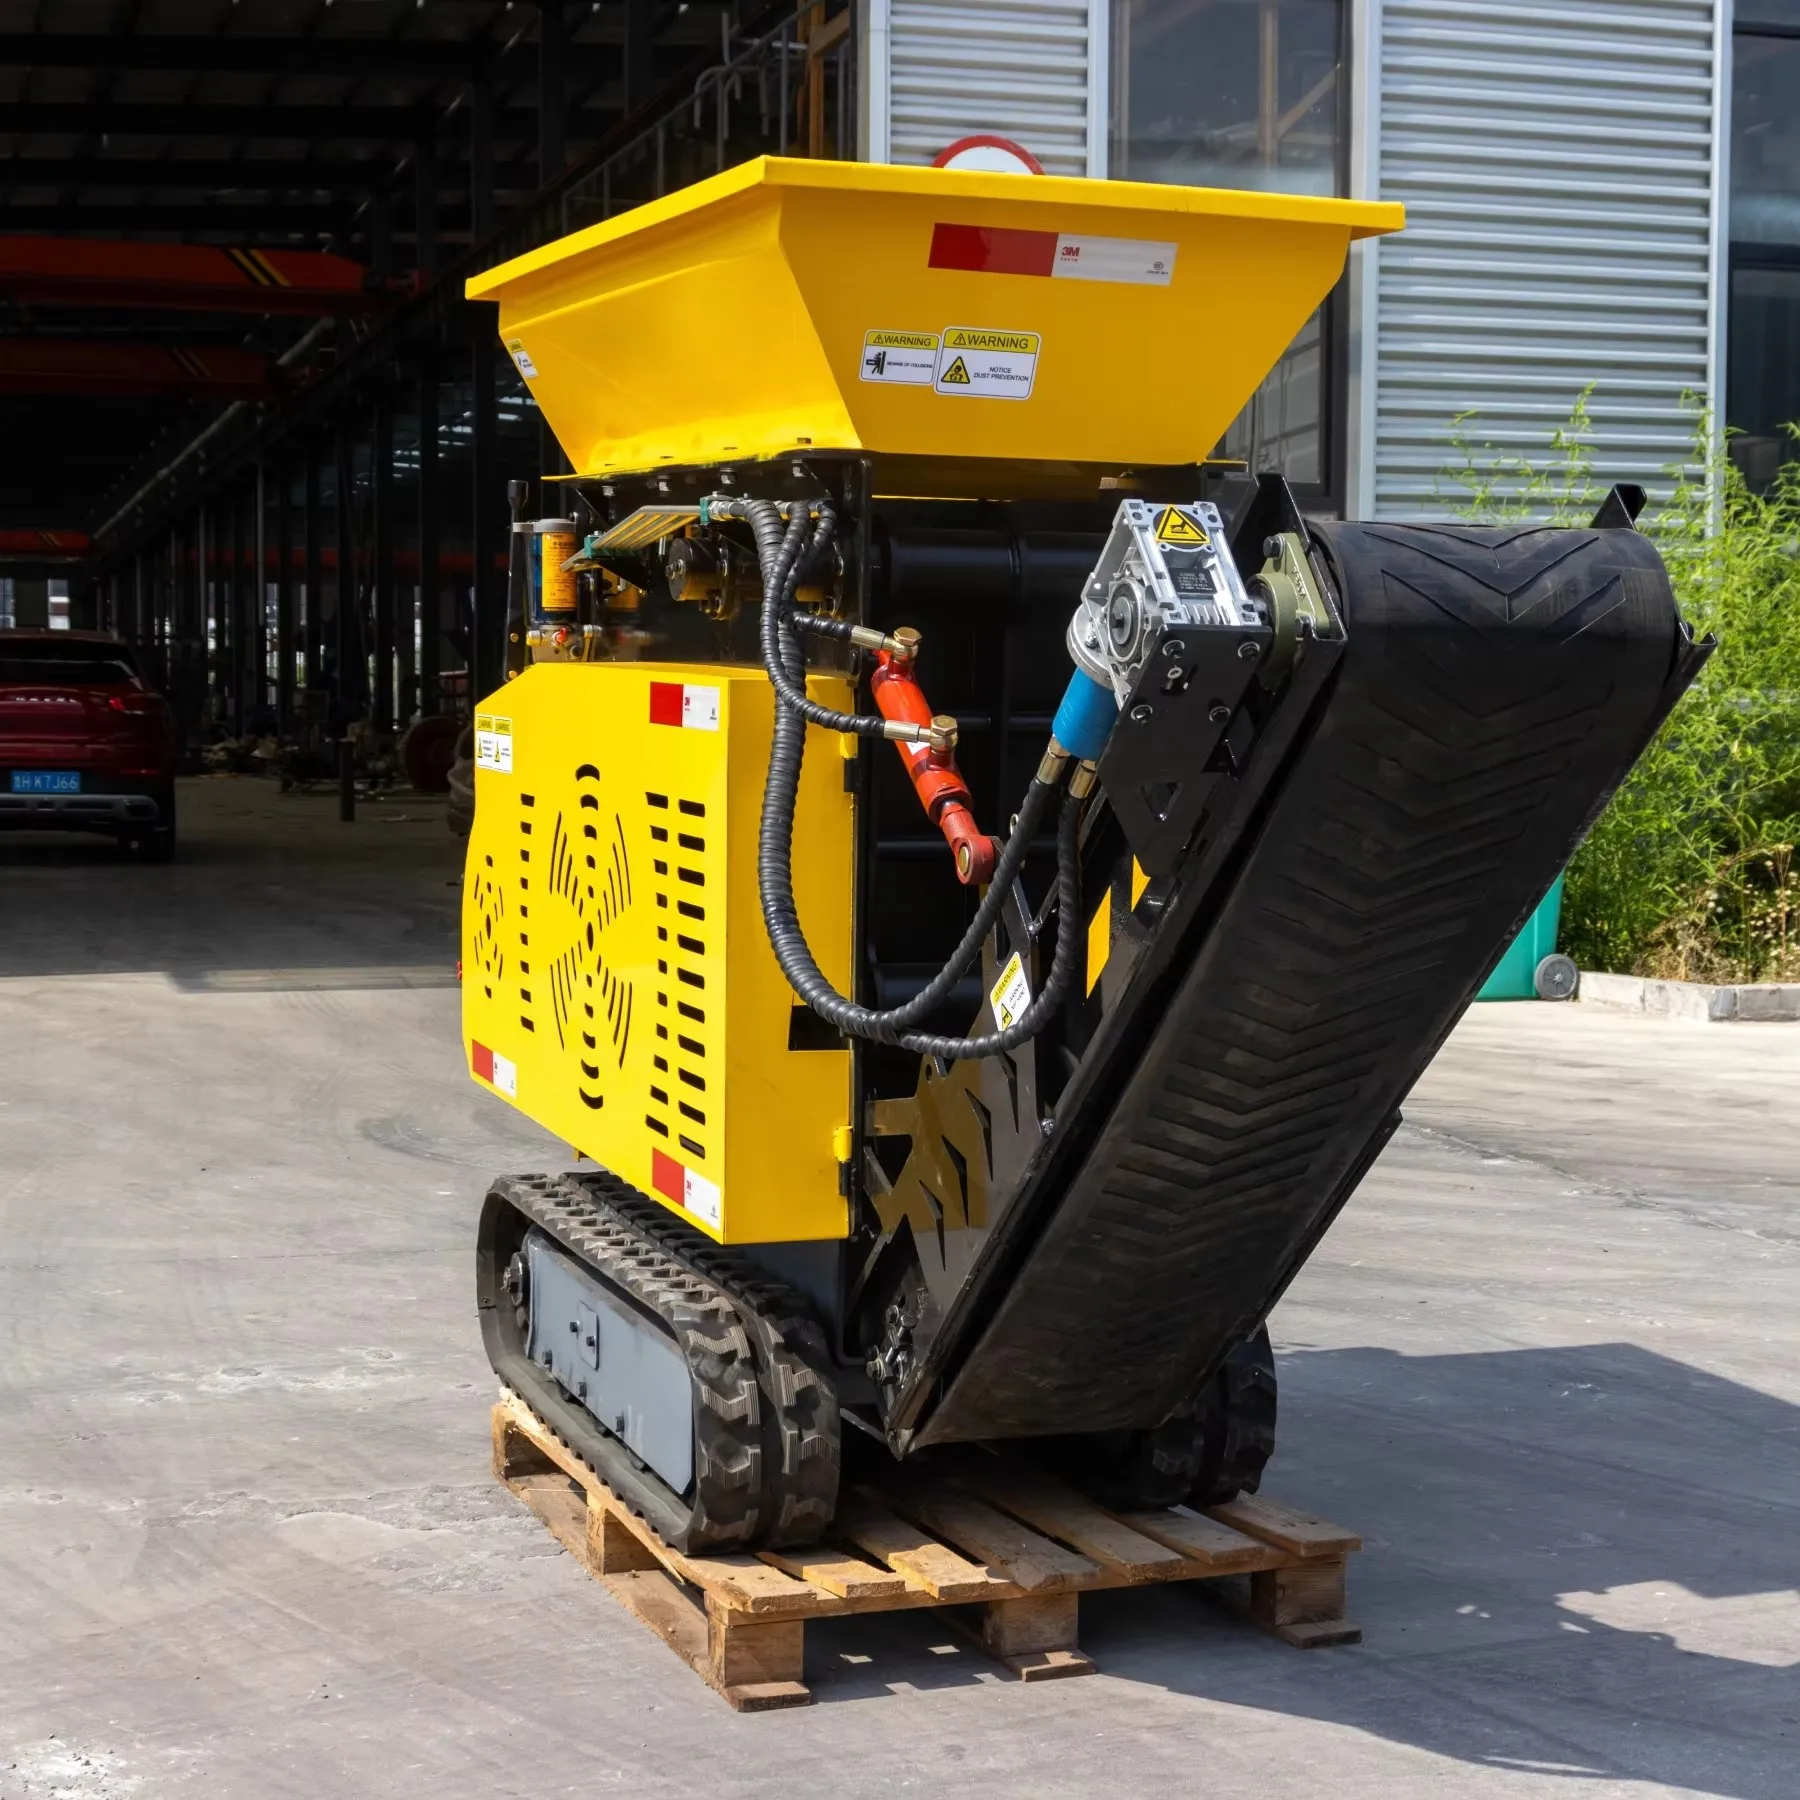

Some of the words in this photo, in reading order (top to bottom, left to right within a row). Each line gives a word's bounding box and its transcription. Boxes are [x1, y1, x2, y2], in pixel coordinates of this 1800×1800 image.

[1061, 246, 1080, 257] 3M
[884, 335, 931, 347] WARNING
[967, 334, 1029, 349] WARNING
[989, 366, 1012, 374] NOTICE
[990, 373, 1029, 382] PREVENTION
